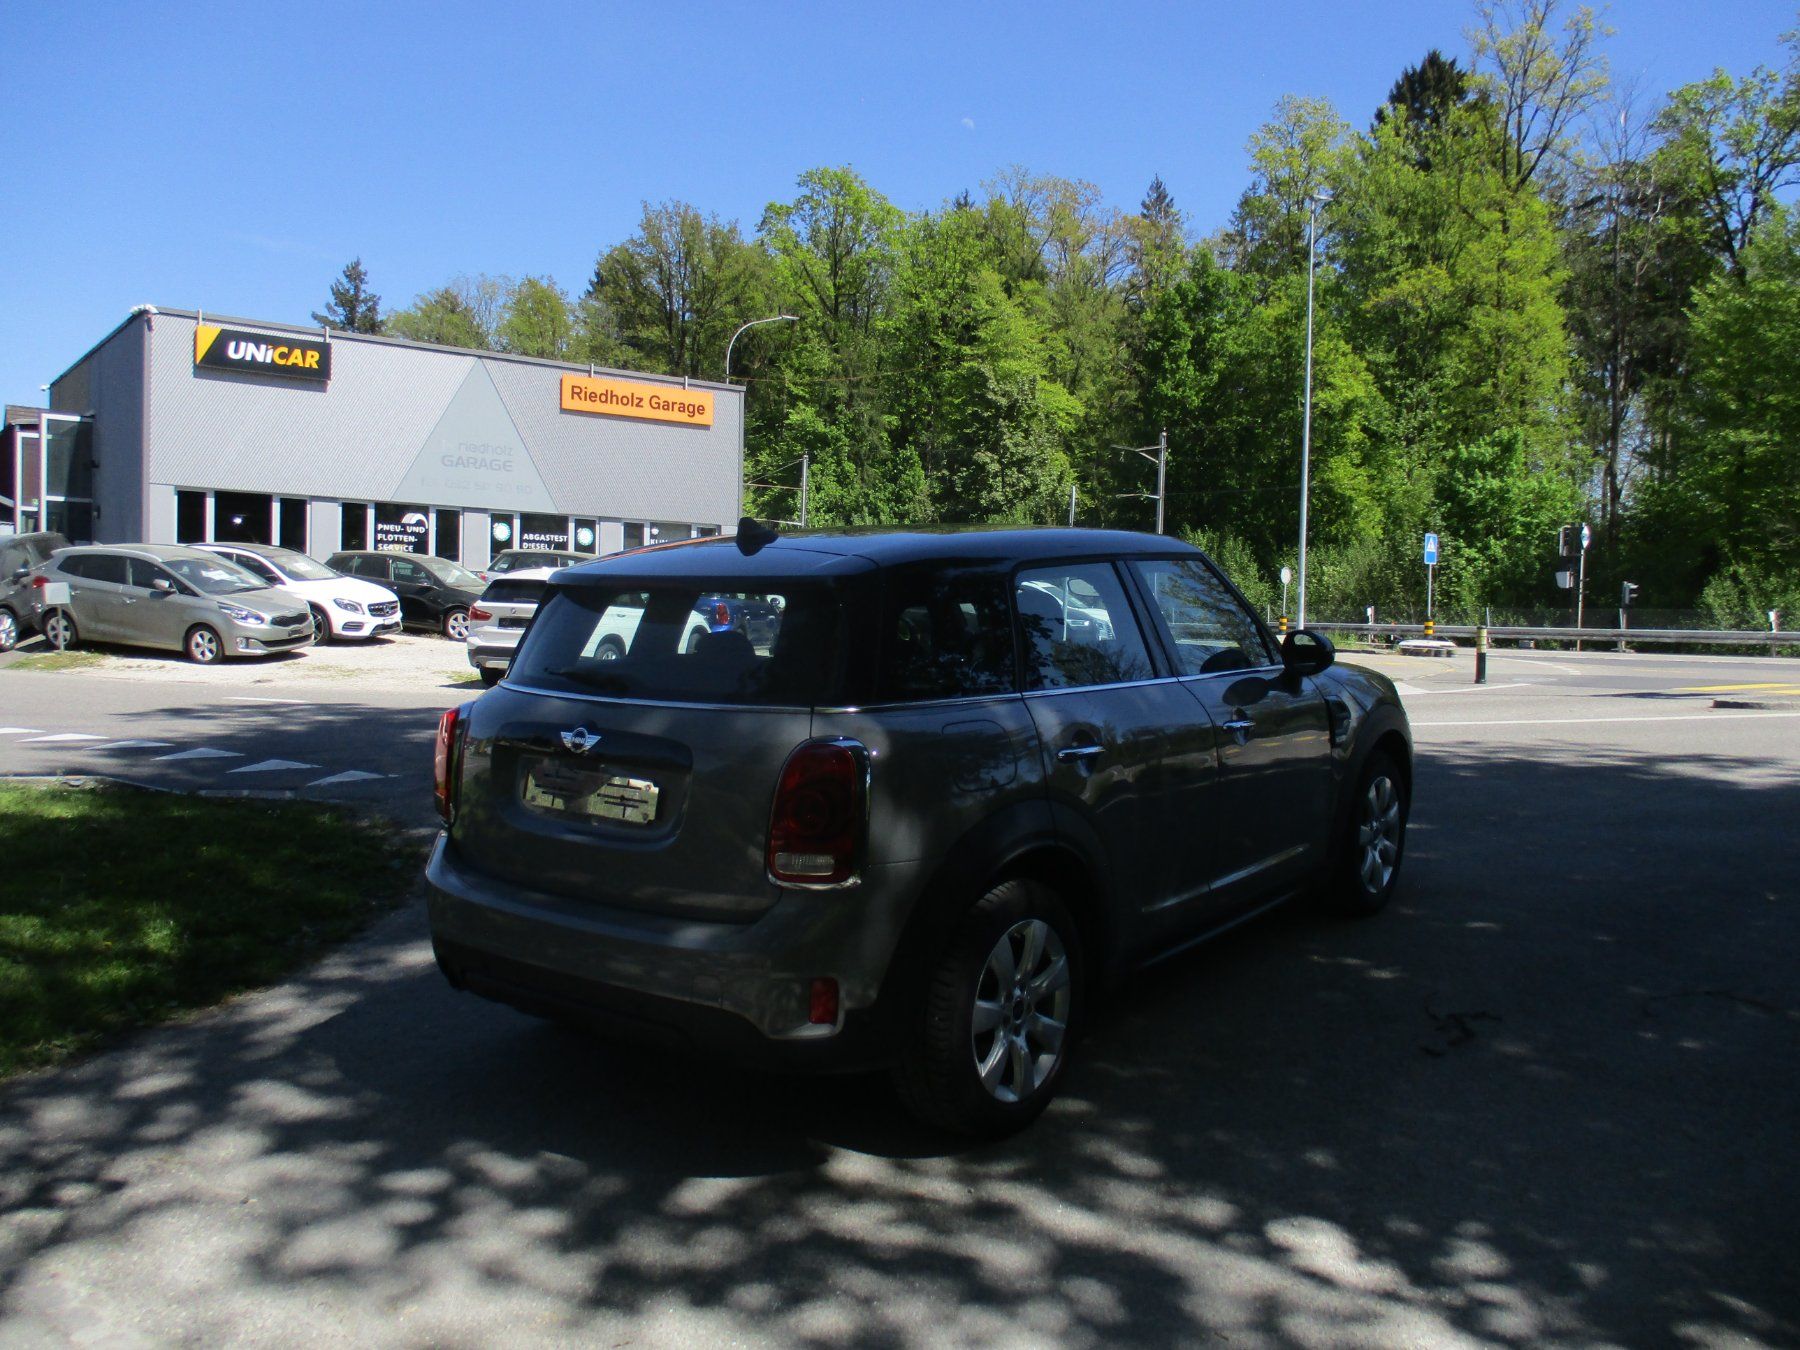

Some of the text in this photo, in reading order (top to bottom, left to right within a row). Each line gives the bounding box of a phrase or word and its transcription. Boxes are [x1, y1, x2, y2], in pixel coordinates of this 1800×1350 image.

[571, 385, 706, 418] Riedholz Garage
[441, 454, 514, 472] GARAGE
[377, 523, 426, 534] PNEU- UND
[377, 533, 418, 543] FLOTTEN-
[522, 533, 568, 543] ABGASTEST
